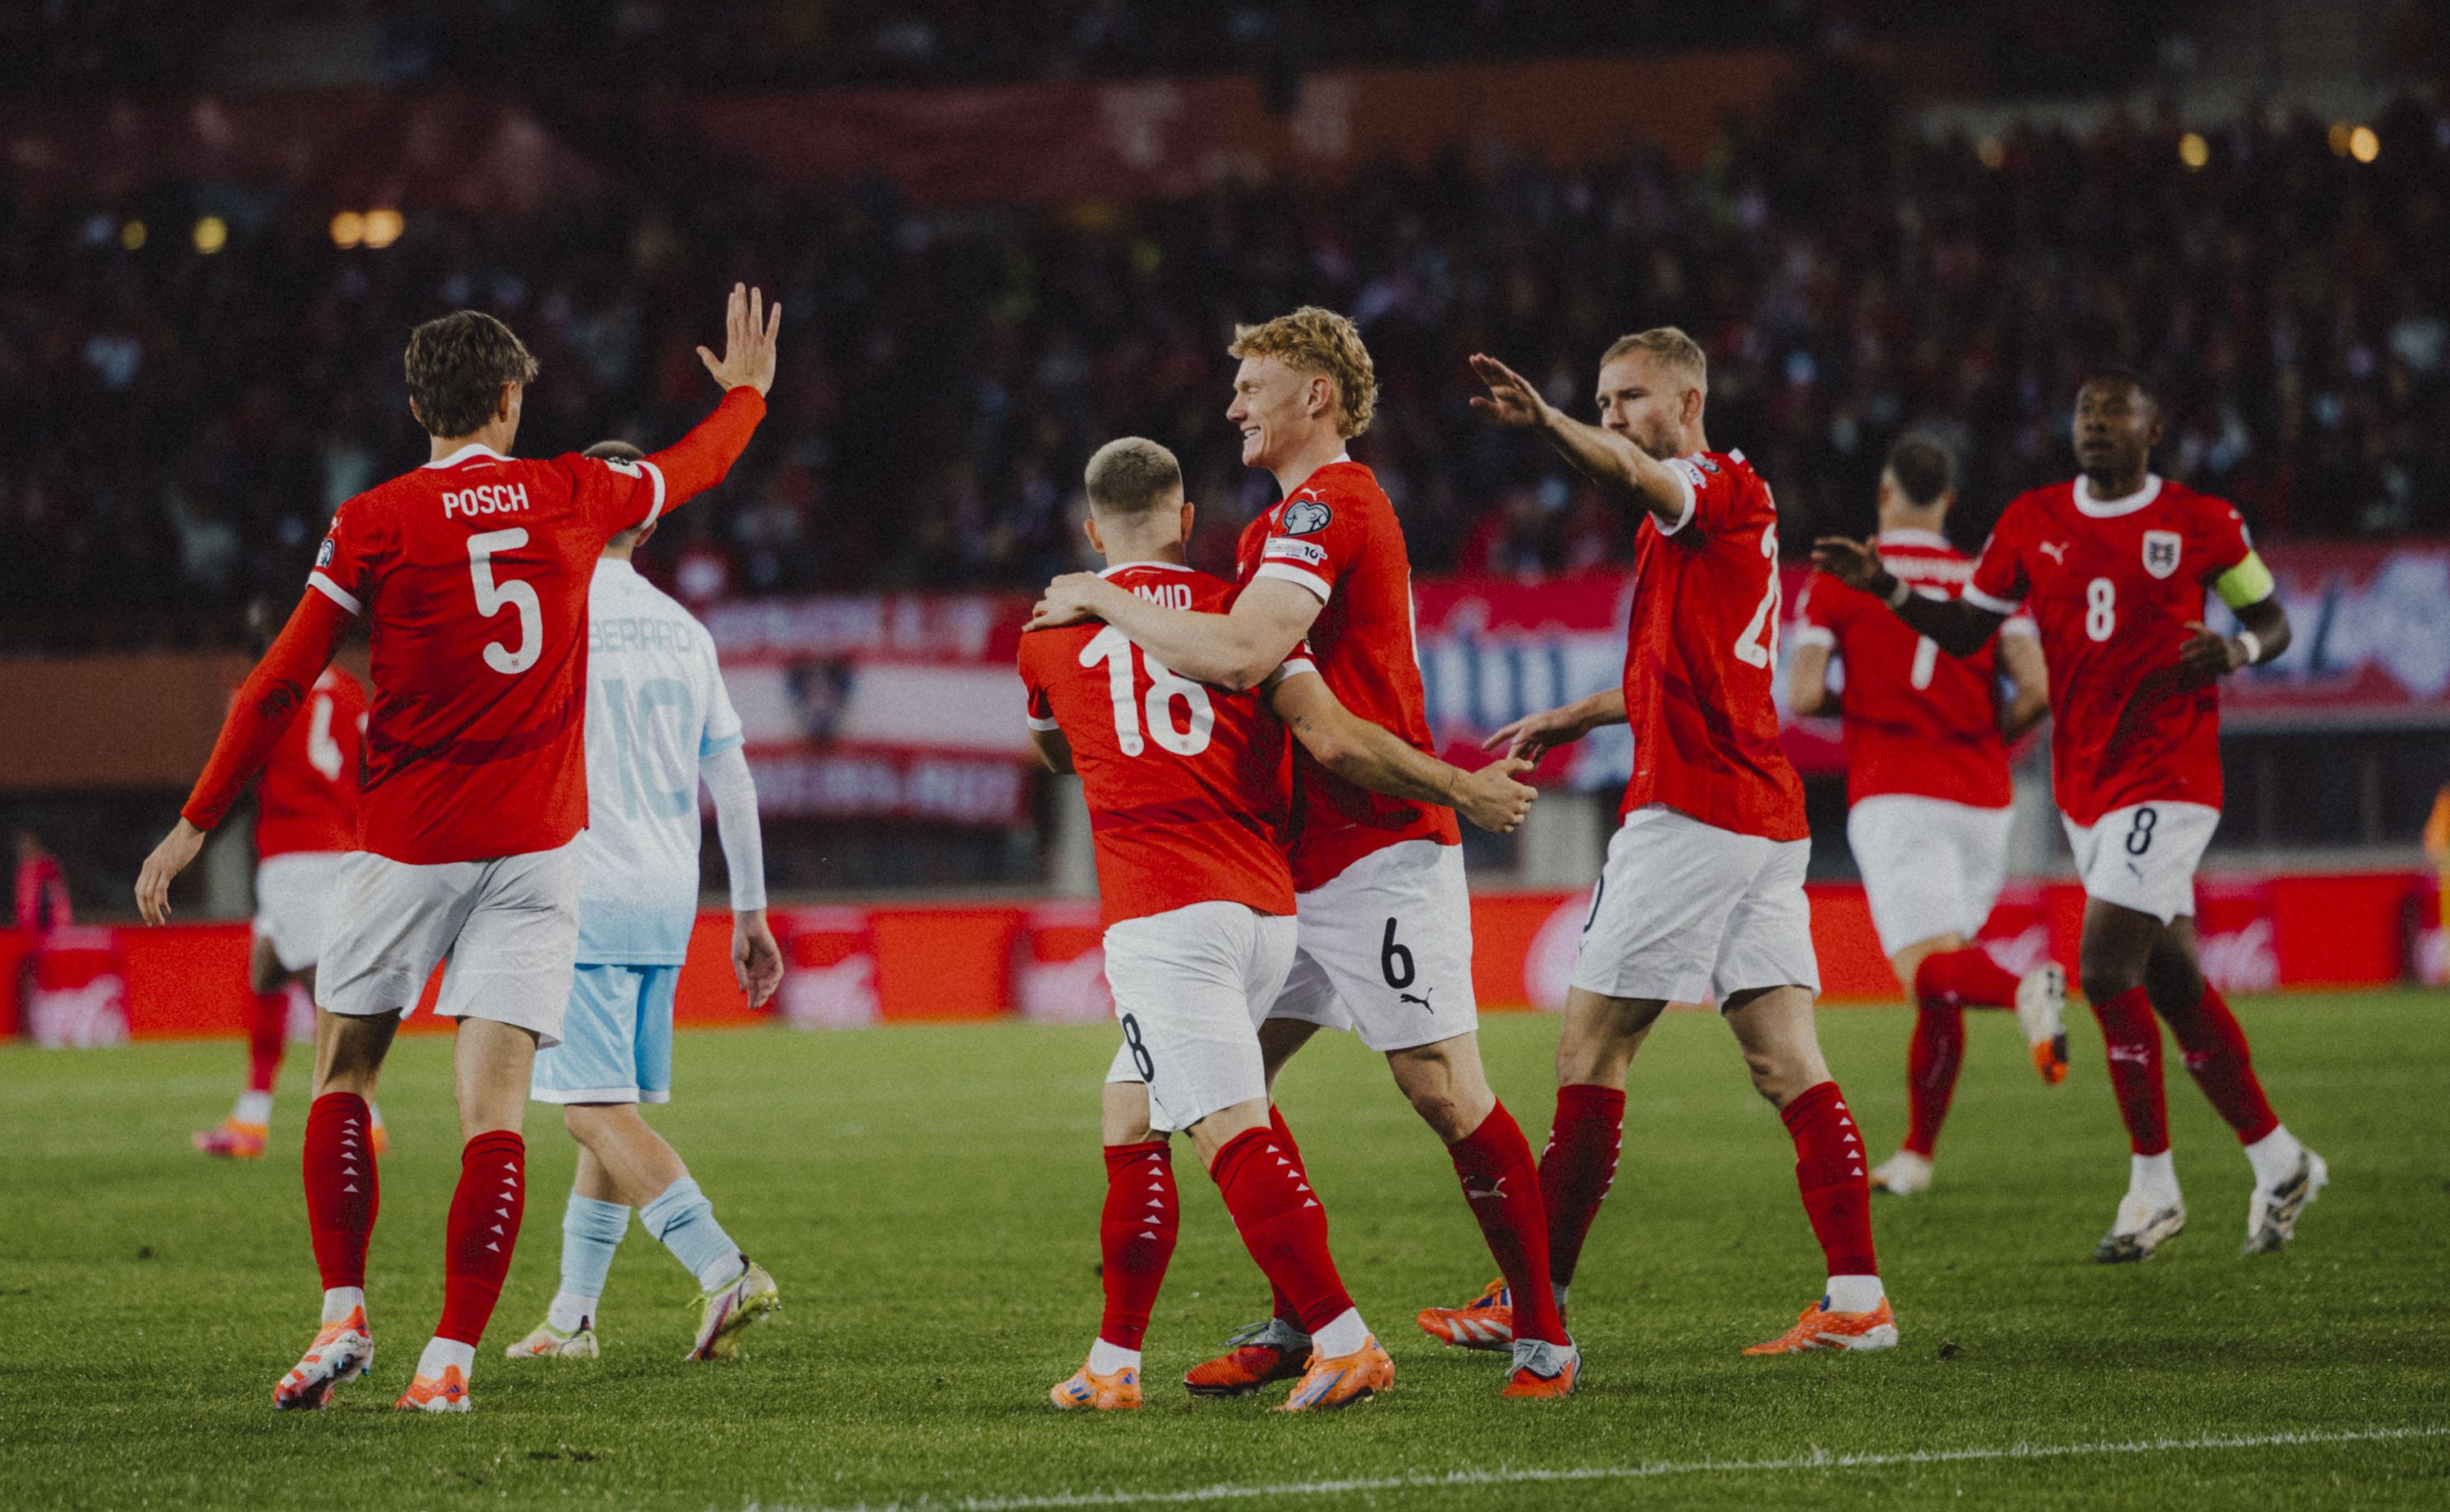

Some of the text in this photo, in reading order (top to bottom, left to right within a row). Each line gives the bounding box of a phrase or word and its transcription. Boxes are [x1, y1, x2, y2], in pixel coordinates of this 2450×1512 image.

[442, 483, 529, 518] POSCH
[466, 527, 542, 674] 5
[2086, 576, 2115, 642] 8
[1079, 625, 1215, 757] 18
[602, 678, 693, 820] 10
[2127, 807, 2158, 856] 8
[1381, 917, 1415, 989] 6
[1122, 1013, 1155, 1083] 8
